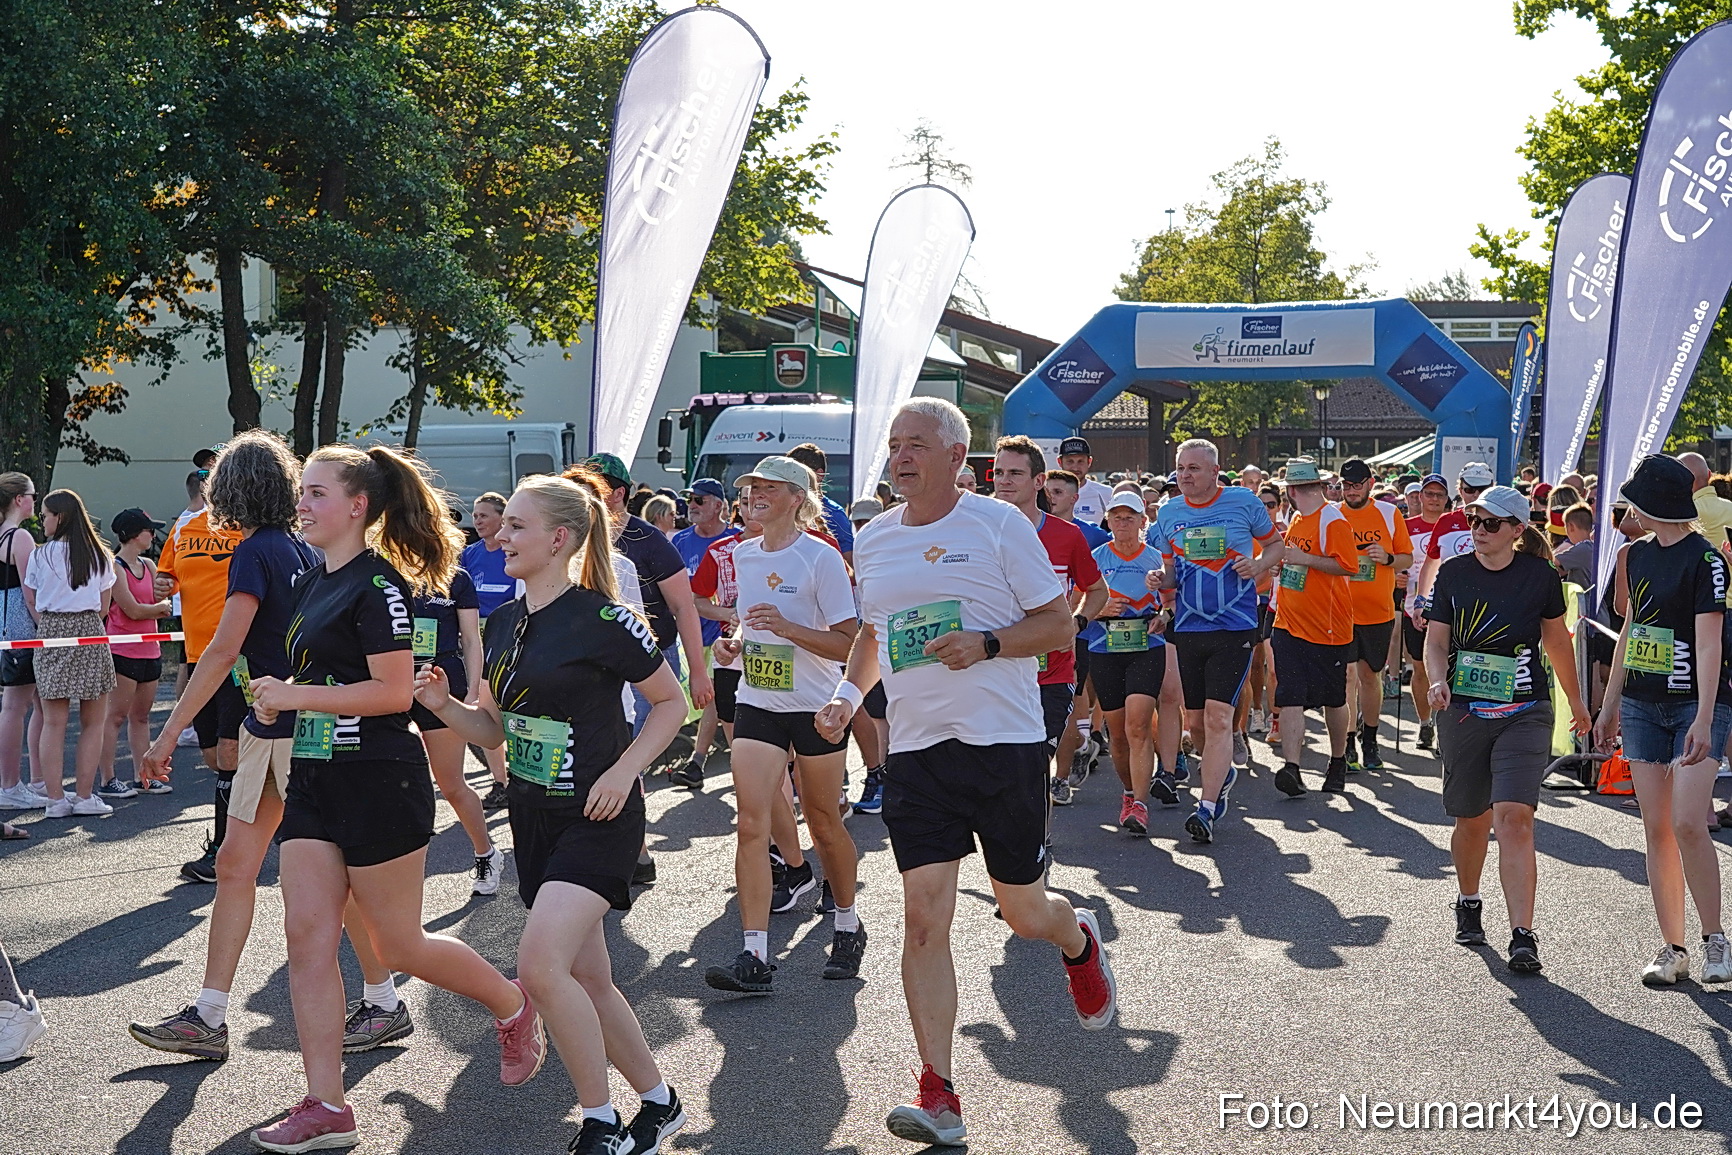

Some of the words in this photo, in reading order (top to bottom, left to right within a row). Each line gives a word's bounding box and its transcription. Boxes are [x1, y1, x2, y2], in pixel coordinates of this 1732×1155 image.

[655, 48, 721, 196] Fischer
[1580, 200, 1625, 303] Fischer
[1227, 338, 1316, 356] firmenlauf
[1057, 368, 1104, 379] Fischer
[1403, 367, 1416, 376] und
[714, 432, 754, 442] abavent
[190, 537, 243, 551] WING
[1200, 538, 1207, 549] 4
[904, 622, 941, 648] 337
[1123, 631, 1131, 642] 9
[891, 639, 899, 660] RUN
[1636, 640, 1658, 658] 671
[748, 657, 783, 676] 1978
[1469, 668, 1500, 685] 666
[1504, 675, 1513, 695] 2022
[1464, 682, 1483, 690] Gruber
[297, 718, 315, 738] 61
[322, 722, 331, 750] 2022
[516, 736, 544, 762] 673
[527, 761, 543, 772] Emma
[549, 747, 562, 778] 2022
